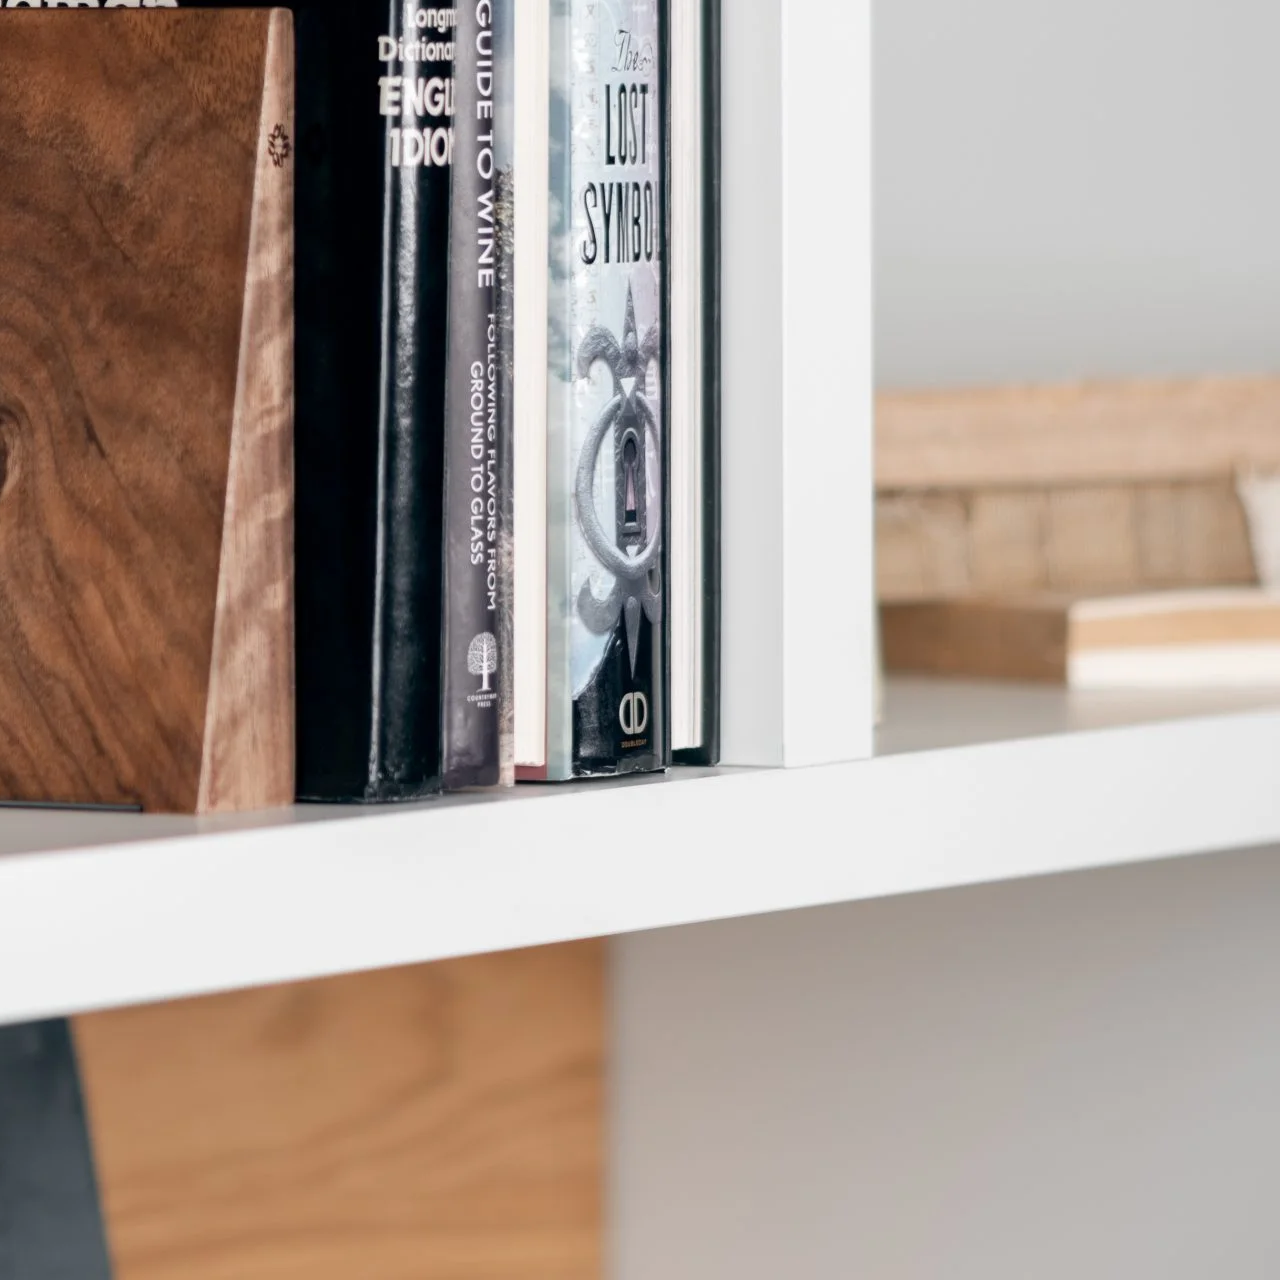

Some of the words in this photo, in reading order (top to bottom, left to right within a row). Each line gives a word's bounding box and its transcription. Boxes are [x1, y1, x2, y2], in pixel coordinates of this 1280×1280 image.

[406, 3, 456, 32] Longm
[611, 29, 651, 72] The
[389, 126, 455, 168] IDIO
[476, 129, 494, 180] TO
[605, 82, 648, 165] LOST
[477, 189, 495, 289] WINE
[470, 360, 484, 460] GROUND
[487, 313, 496, 442] FOLLOWING
[470, 464, 484, 493] TO
[487, 449, 496, 542] FLAVORS
[470, 497, 484, 566] GLASS
[487, 548, 496, 611] FROM
